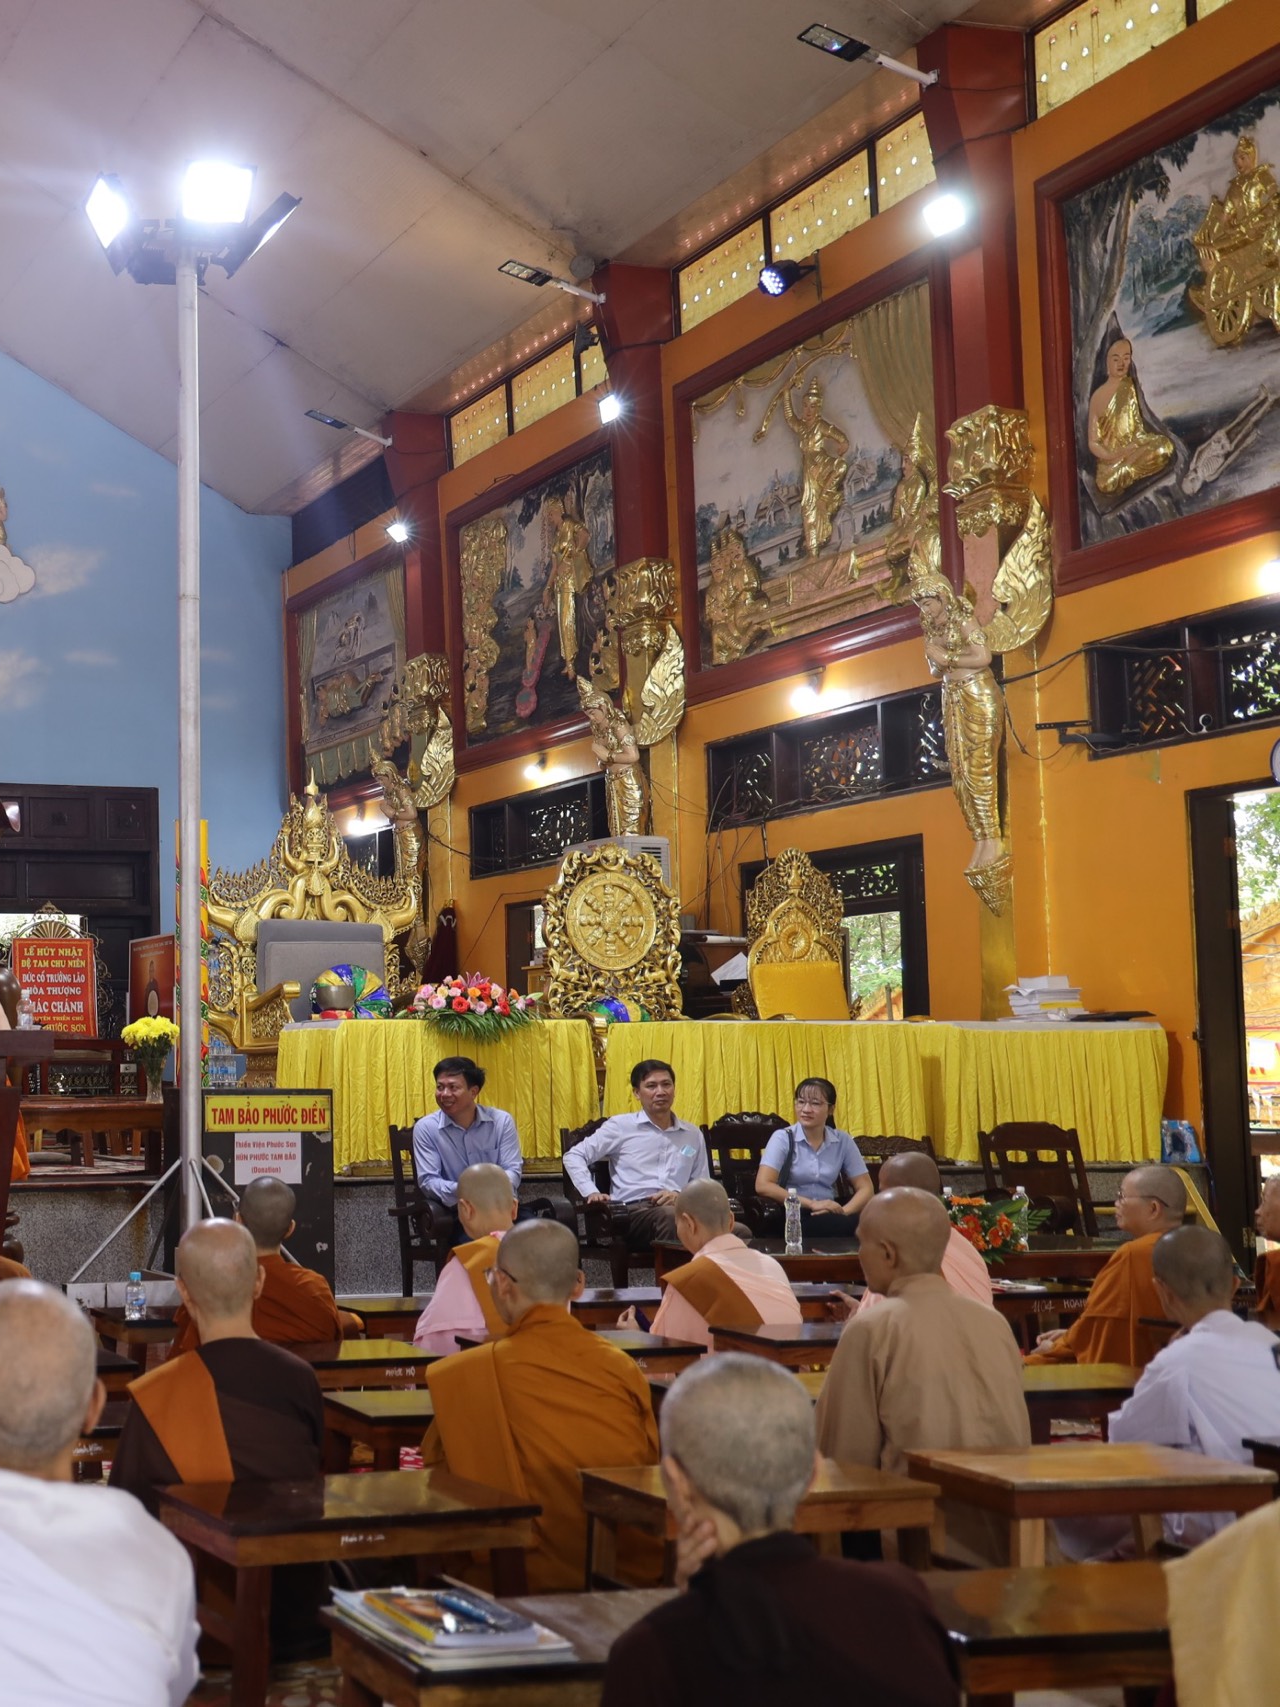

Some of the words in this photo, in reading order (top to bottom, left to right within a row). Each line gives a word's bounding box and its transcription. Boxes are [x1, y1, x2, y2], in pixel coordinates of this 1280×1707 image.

[58, 946, 83, 958] NHẬT
[33, 959, 49, 968] TAM
[51, 959, 66, 968] CHU
[37, 970, 46, 983] CỐ
[46, 985, 82, 997] THƯỢNG
[51, 998, 84, 1013] CHÁNH
[71, 1023, 87, 1032] SƠN
[211, 1108, 235, 1125] TAM
[238, 1101, 260, 1125] BẢO
[263, 1103, 298, 1125] PHƯỚC
[301, 1101, 326, 1125] ĐIỀN
